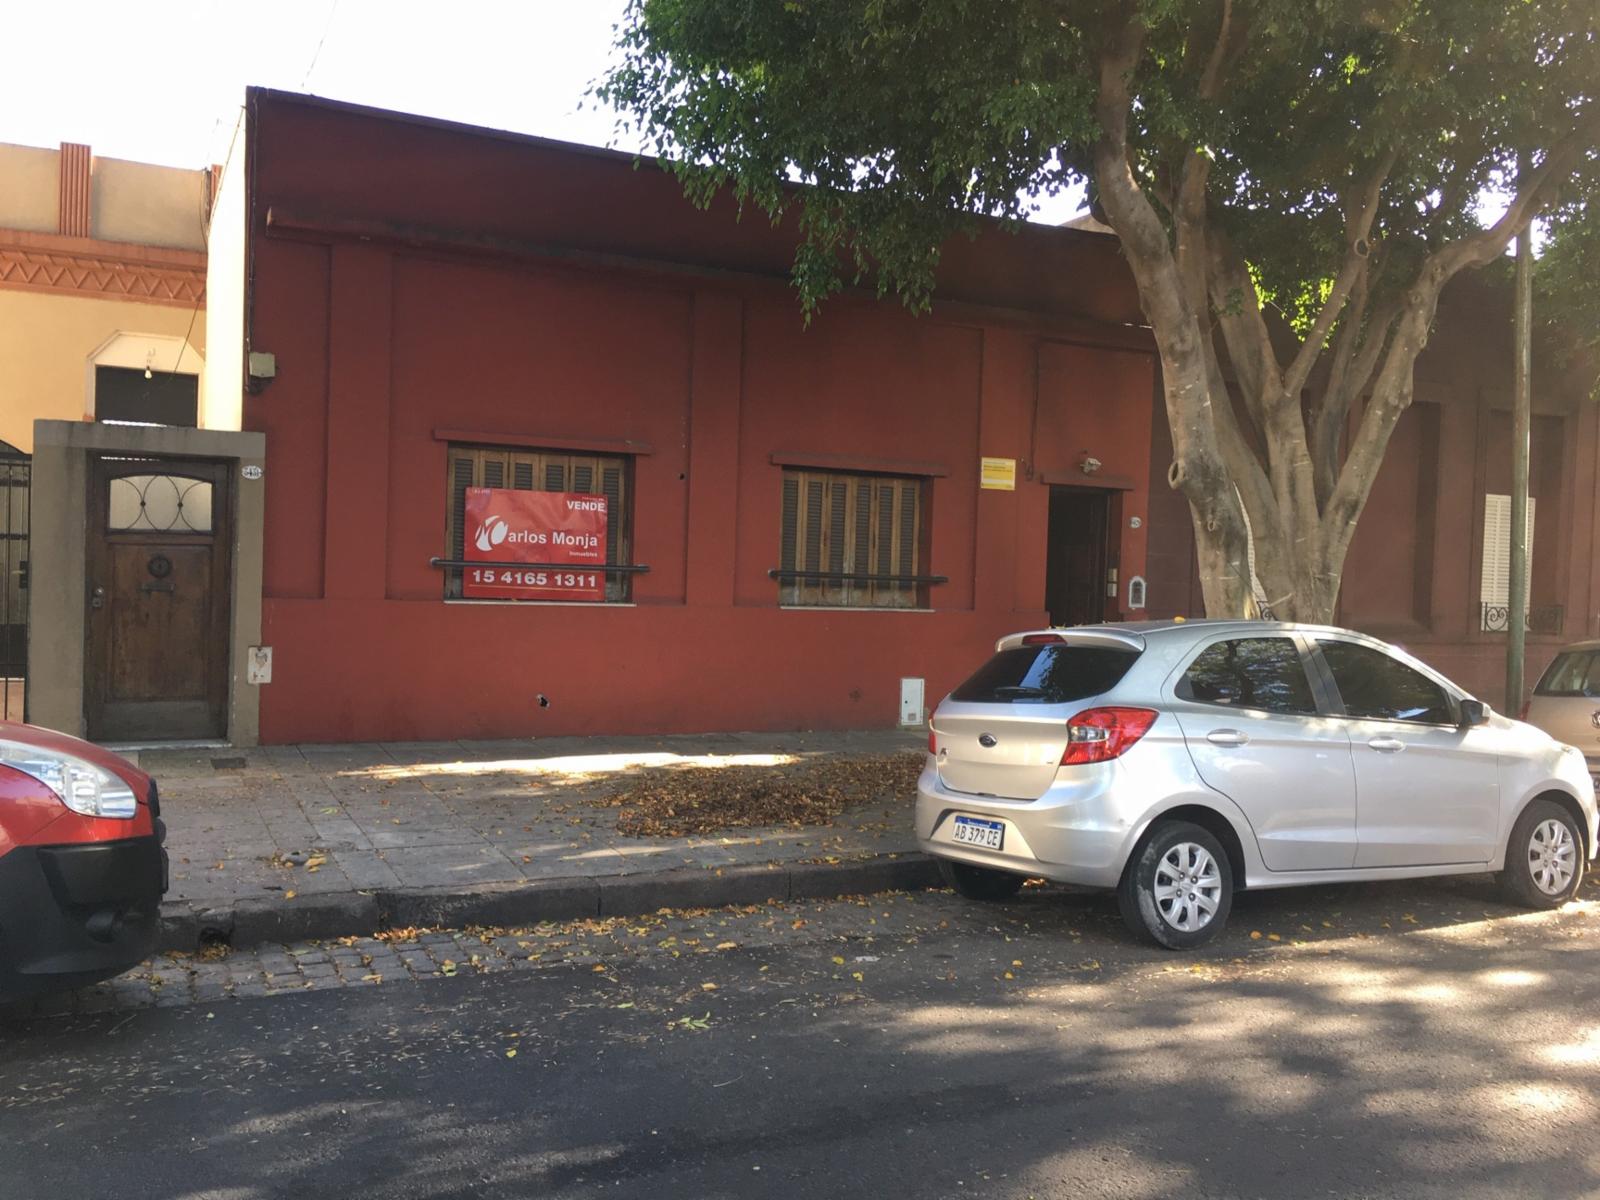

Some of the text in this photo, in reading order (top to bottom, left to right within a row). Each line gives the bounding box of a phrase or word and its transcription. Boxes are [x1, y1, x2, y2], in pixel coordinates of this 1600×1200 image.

[566, 500, 605, 512] VENDE
[552, 531, 598, 549] Monja
[473, 570, 596, 587] 15 4165 1311
[954, 824, 967, 840] AB
[968, 827, 985, 843] 379
[987, 830, 999, 847] CE
